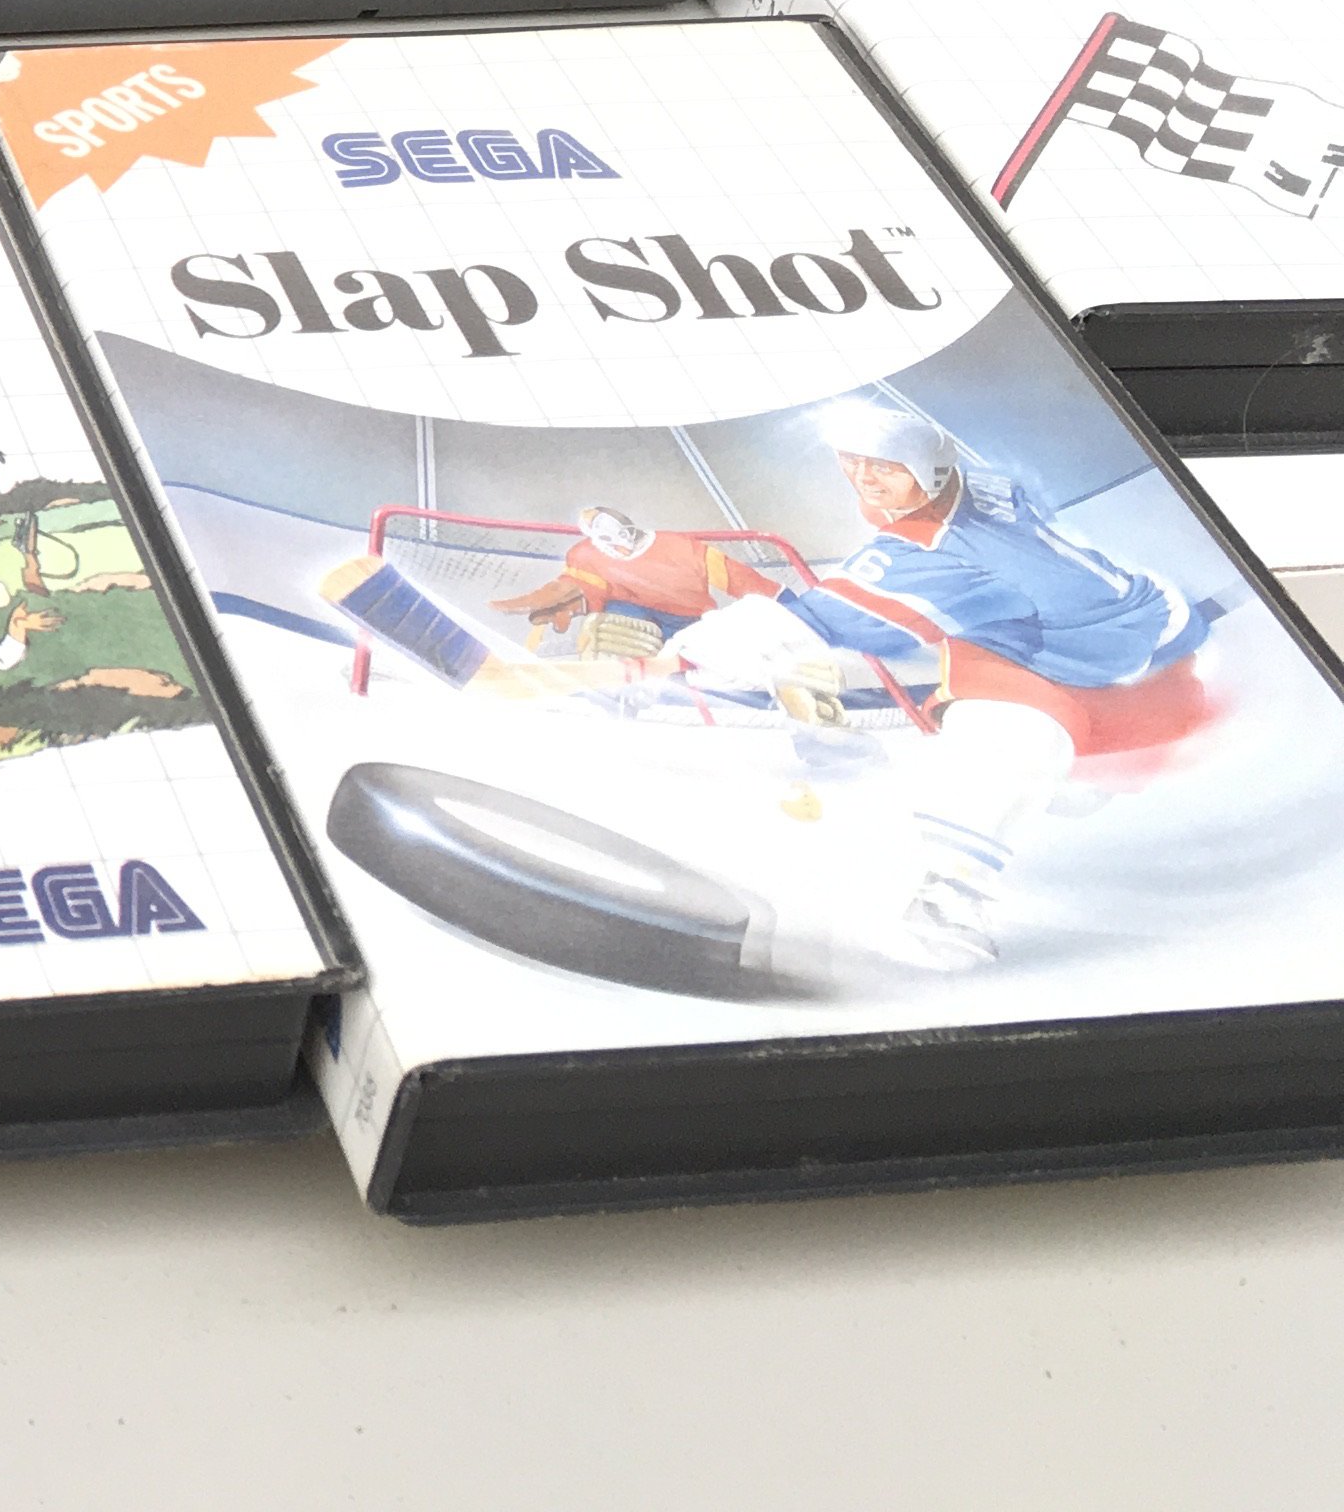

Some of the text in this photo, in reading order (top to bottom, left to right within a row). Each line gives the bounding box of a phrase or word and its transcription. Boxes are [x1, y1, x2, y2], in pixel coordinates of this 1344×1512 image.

[34, 64, 207, 160] SPORTS
[321, 128, 623, 189] SEGA
[169, 250, 539, 357] Slap
[565, 227, 941, 323] Shot
